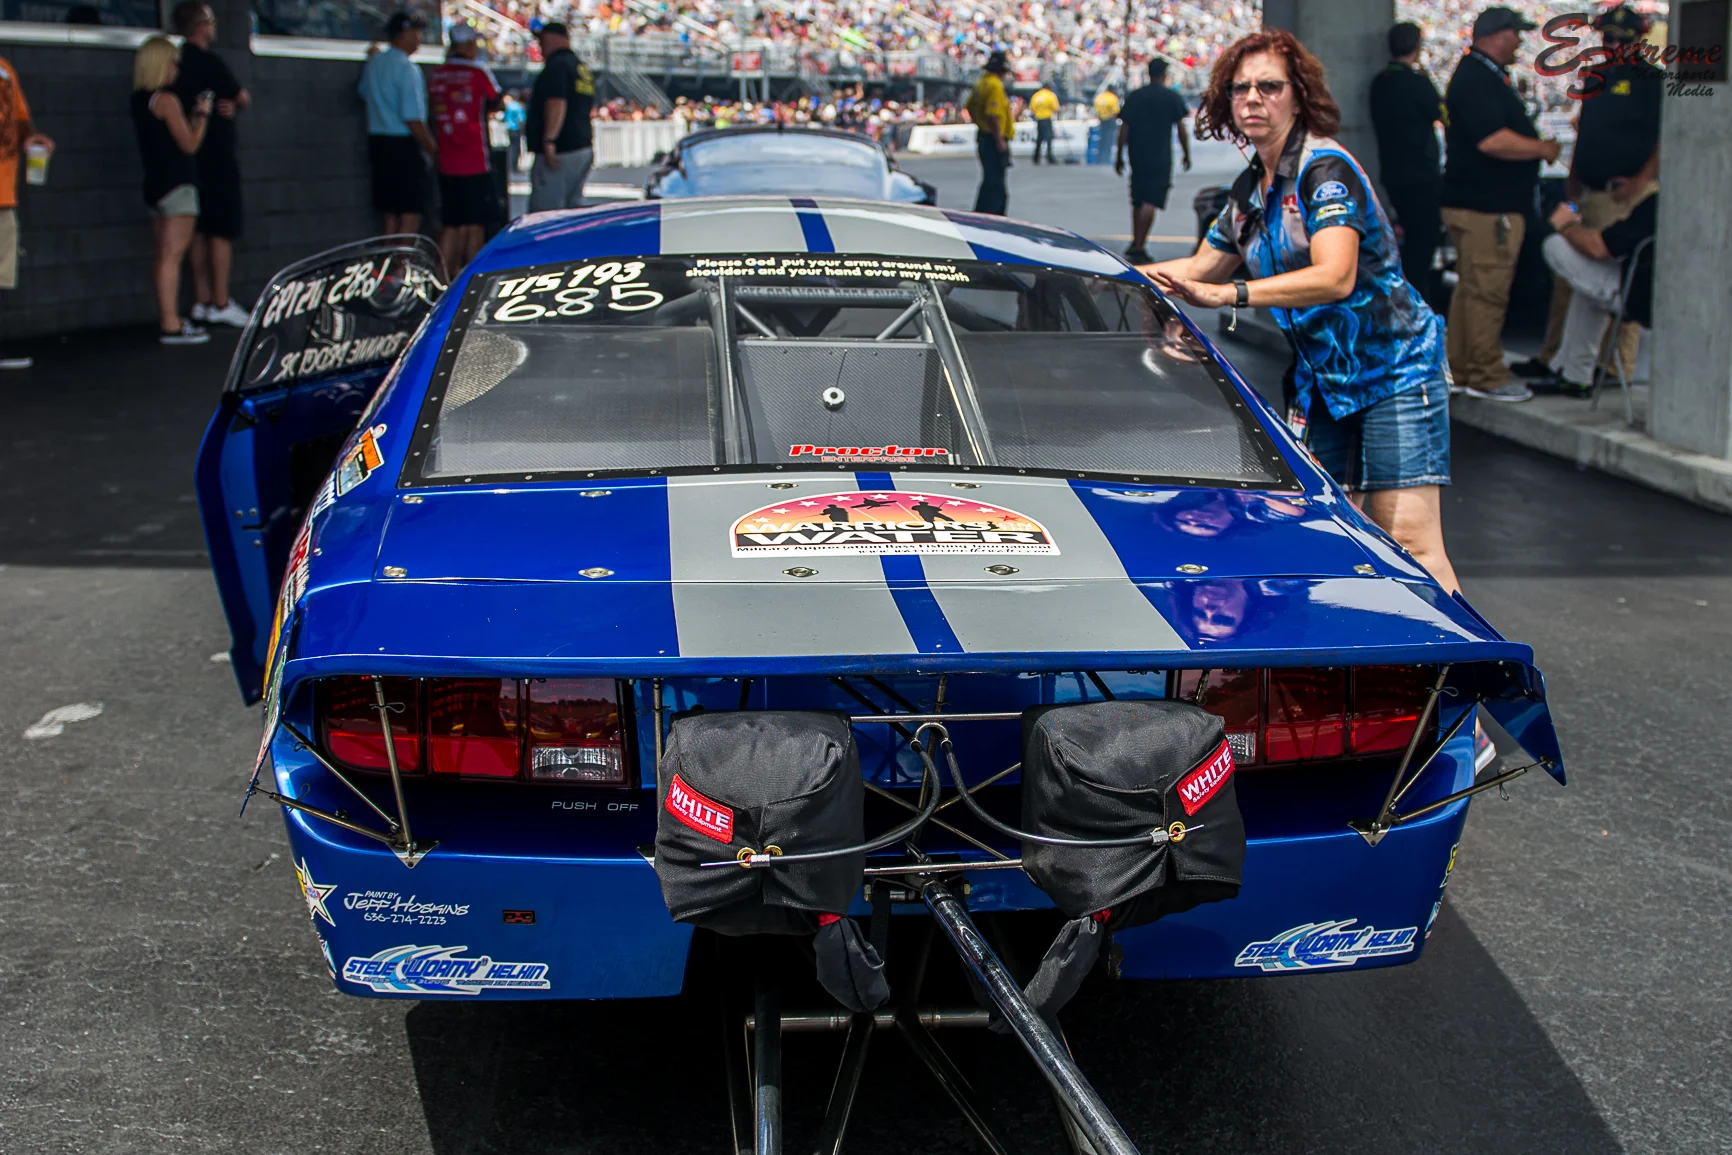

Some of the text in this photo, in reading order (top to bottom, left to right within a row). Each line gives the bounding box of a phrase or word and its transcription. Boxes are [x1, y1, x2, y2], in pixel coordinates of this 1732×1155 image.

[697, 257, 956, 274] Please God put your arms around my
[567, 261, 646, 288] 193
[686, 266, 970, 282] shoulders and your hand over my mouth
[493, 286, 664, 322] 6.85
[788, 443, 950, 457] Proctor
[743, 520, 993, 532] WARRIORS
[743, 530, 1041, 545] WATER
[1181, 746, 1232, 801] WHITE
[551, 801, 639, 811] PUSH OFF
[671, 782, 731, 830] WHITE
[364, 890, 399, 900] PAINT BY
[363, 912, 447, 926] 636-274-2223
